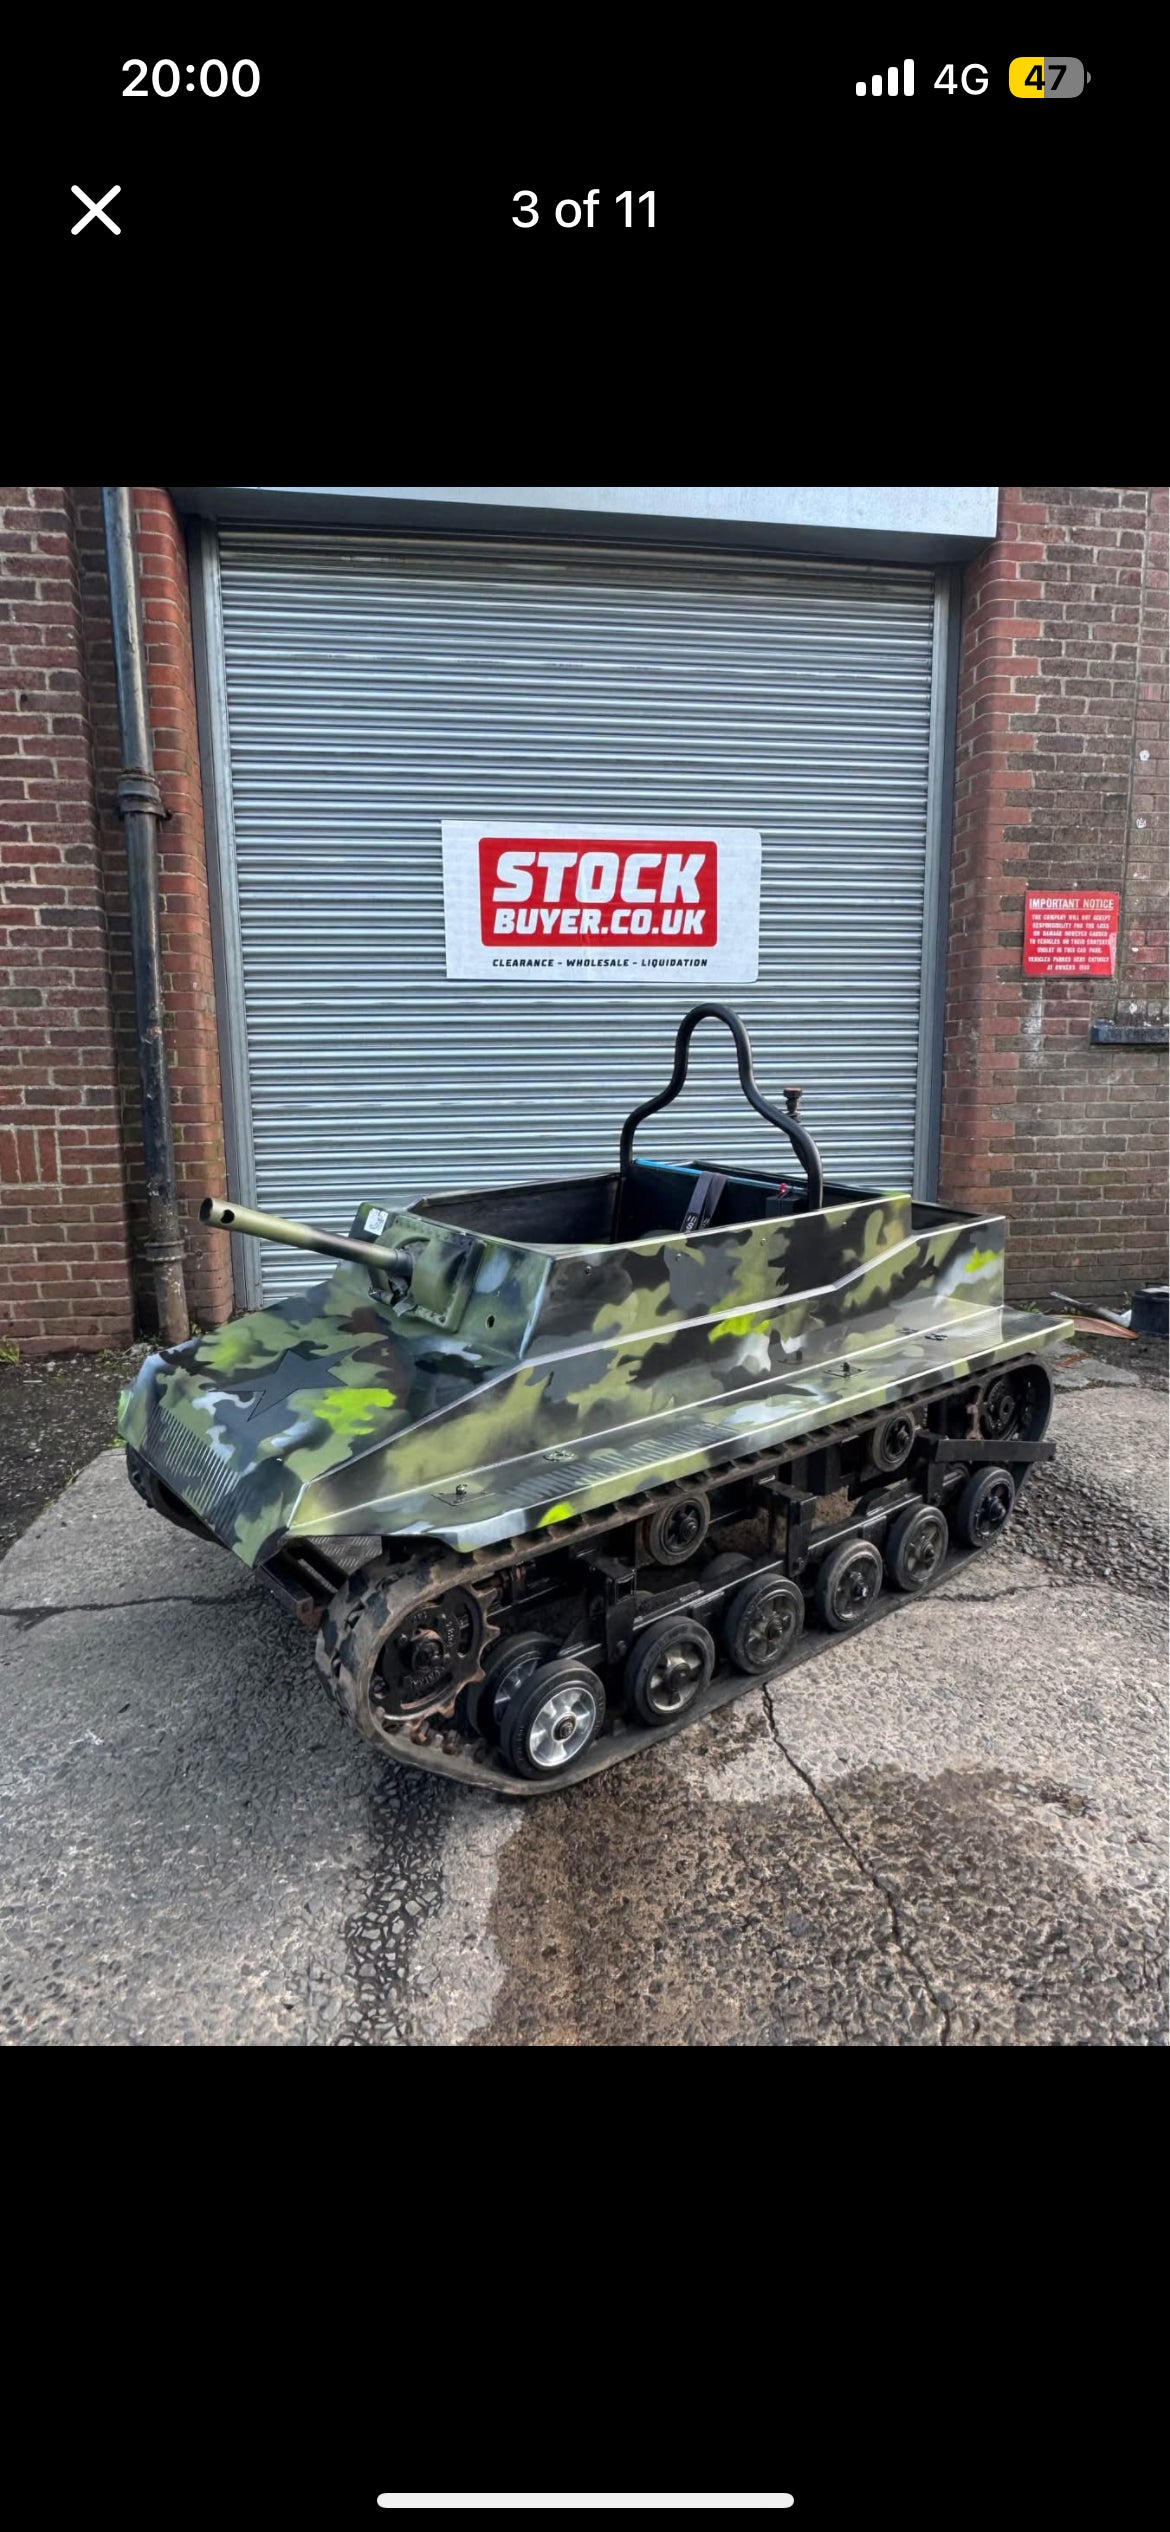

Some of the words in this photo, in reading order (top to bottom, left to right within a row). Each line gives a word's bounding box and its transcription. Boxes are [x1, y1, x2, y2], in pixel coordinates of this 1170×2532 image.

[492, 851, 706, 904] STOCK
[1029, 898, 1080, 909] IMPORTANT
[1083, 899, 1114, 909] NOTICE
[493, 908, 706, 935] BUYER.CO.UK
[492, 958, 555, 967] CLEARANCE
[566, 958, 630, 967] WHOLESALE
[641, 959, 708, 967] LIQUIDATION
